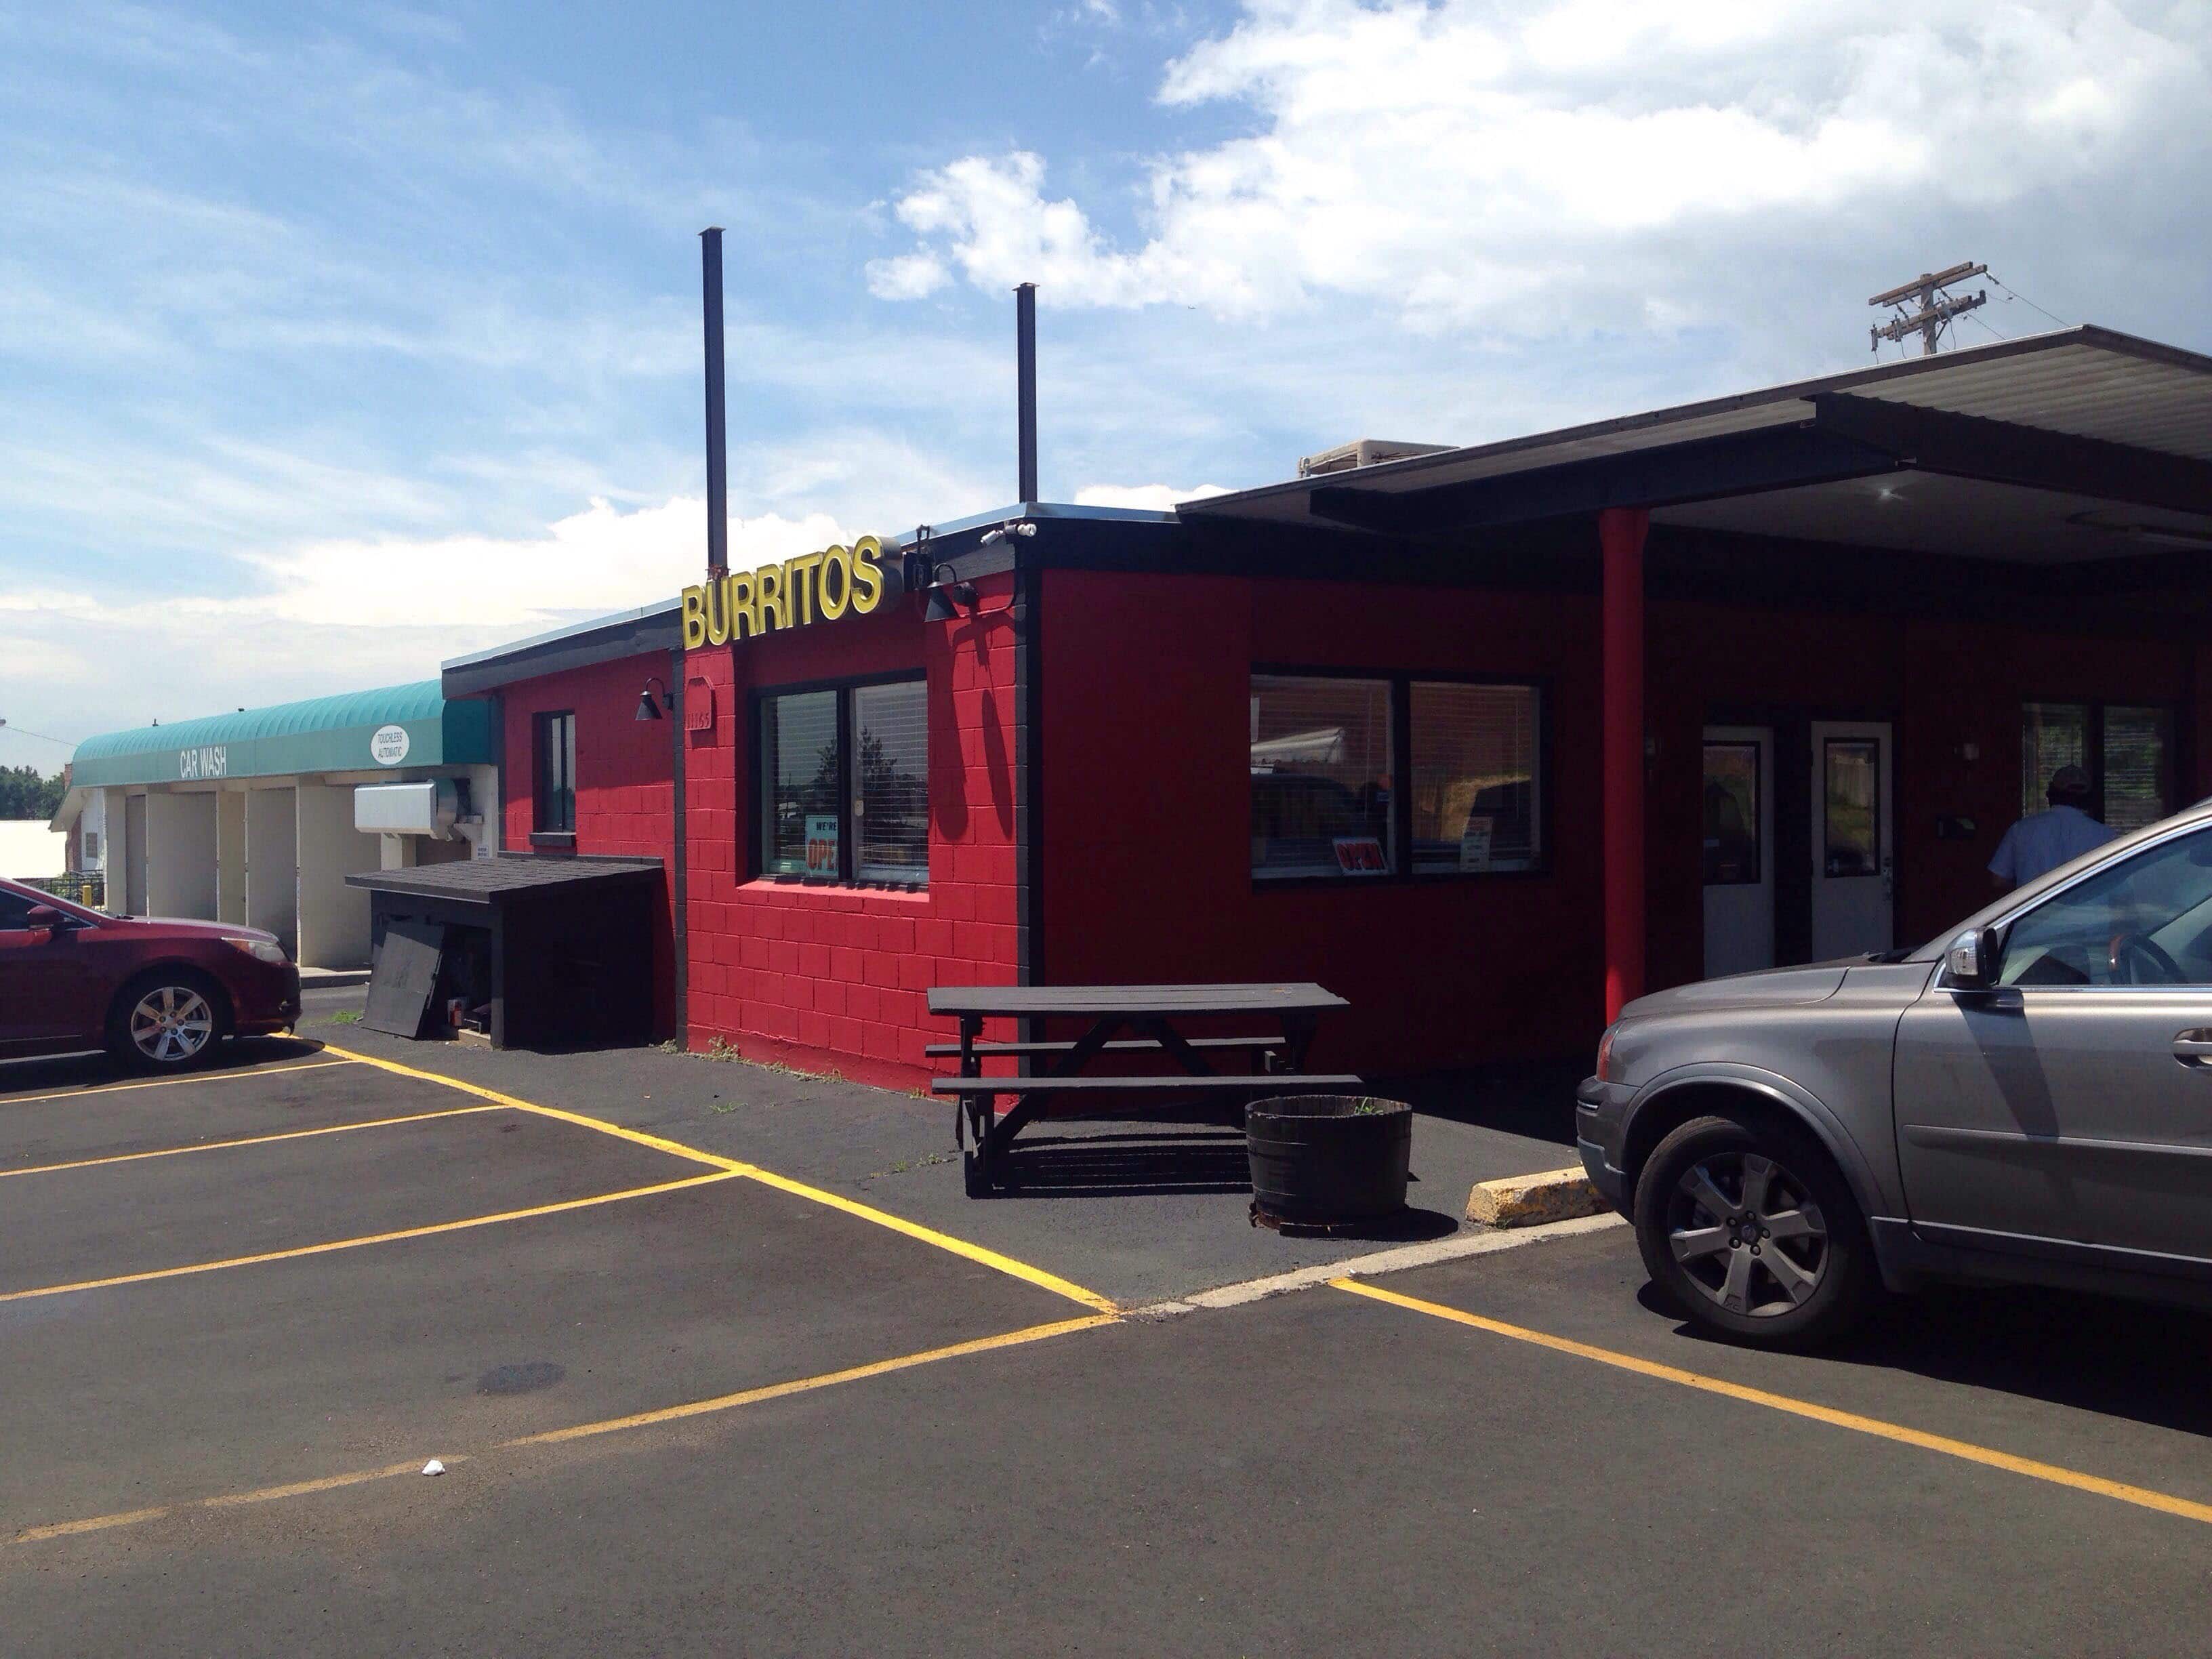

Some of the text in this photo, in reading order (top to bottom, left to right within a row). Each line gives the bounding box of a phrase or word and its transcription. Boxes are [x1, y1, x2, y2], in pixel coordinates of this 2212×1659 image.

[682, 535, 884, 651] BURRITOS
[378, 732, 403, 743] TOUCHLESS
[180, 746, 226, 778] CAR WASH
[377, 747, 403, 758] AUTOMATIC
[816, 822, 837, 831] WE'RE
[808, 838, 838, 872] OPE
[1336, 843, 1385, 870] OPEN
